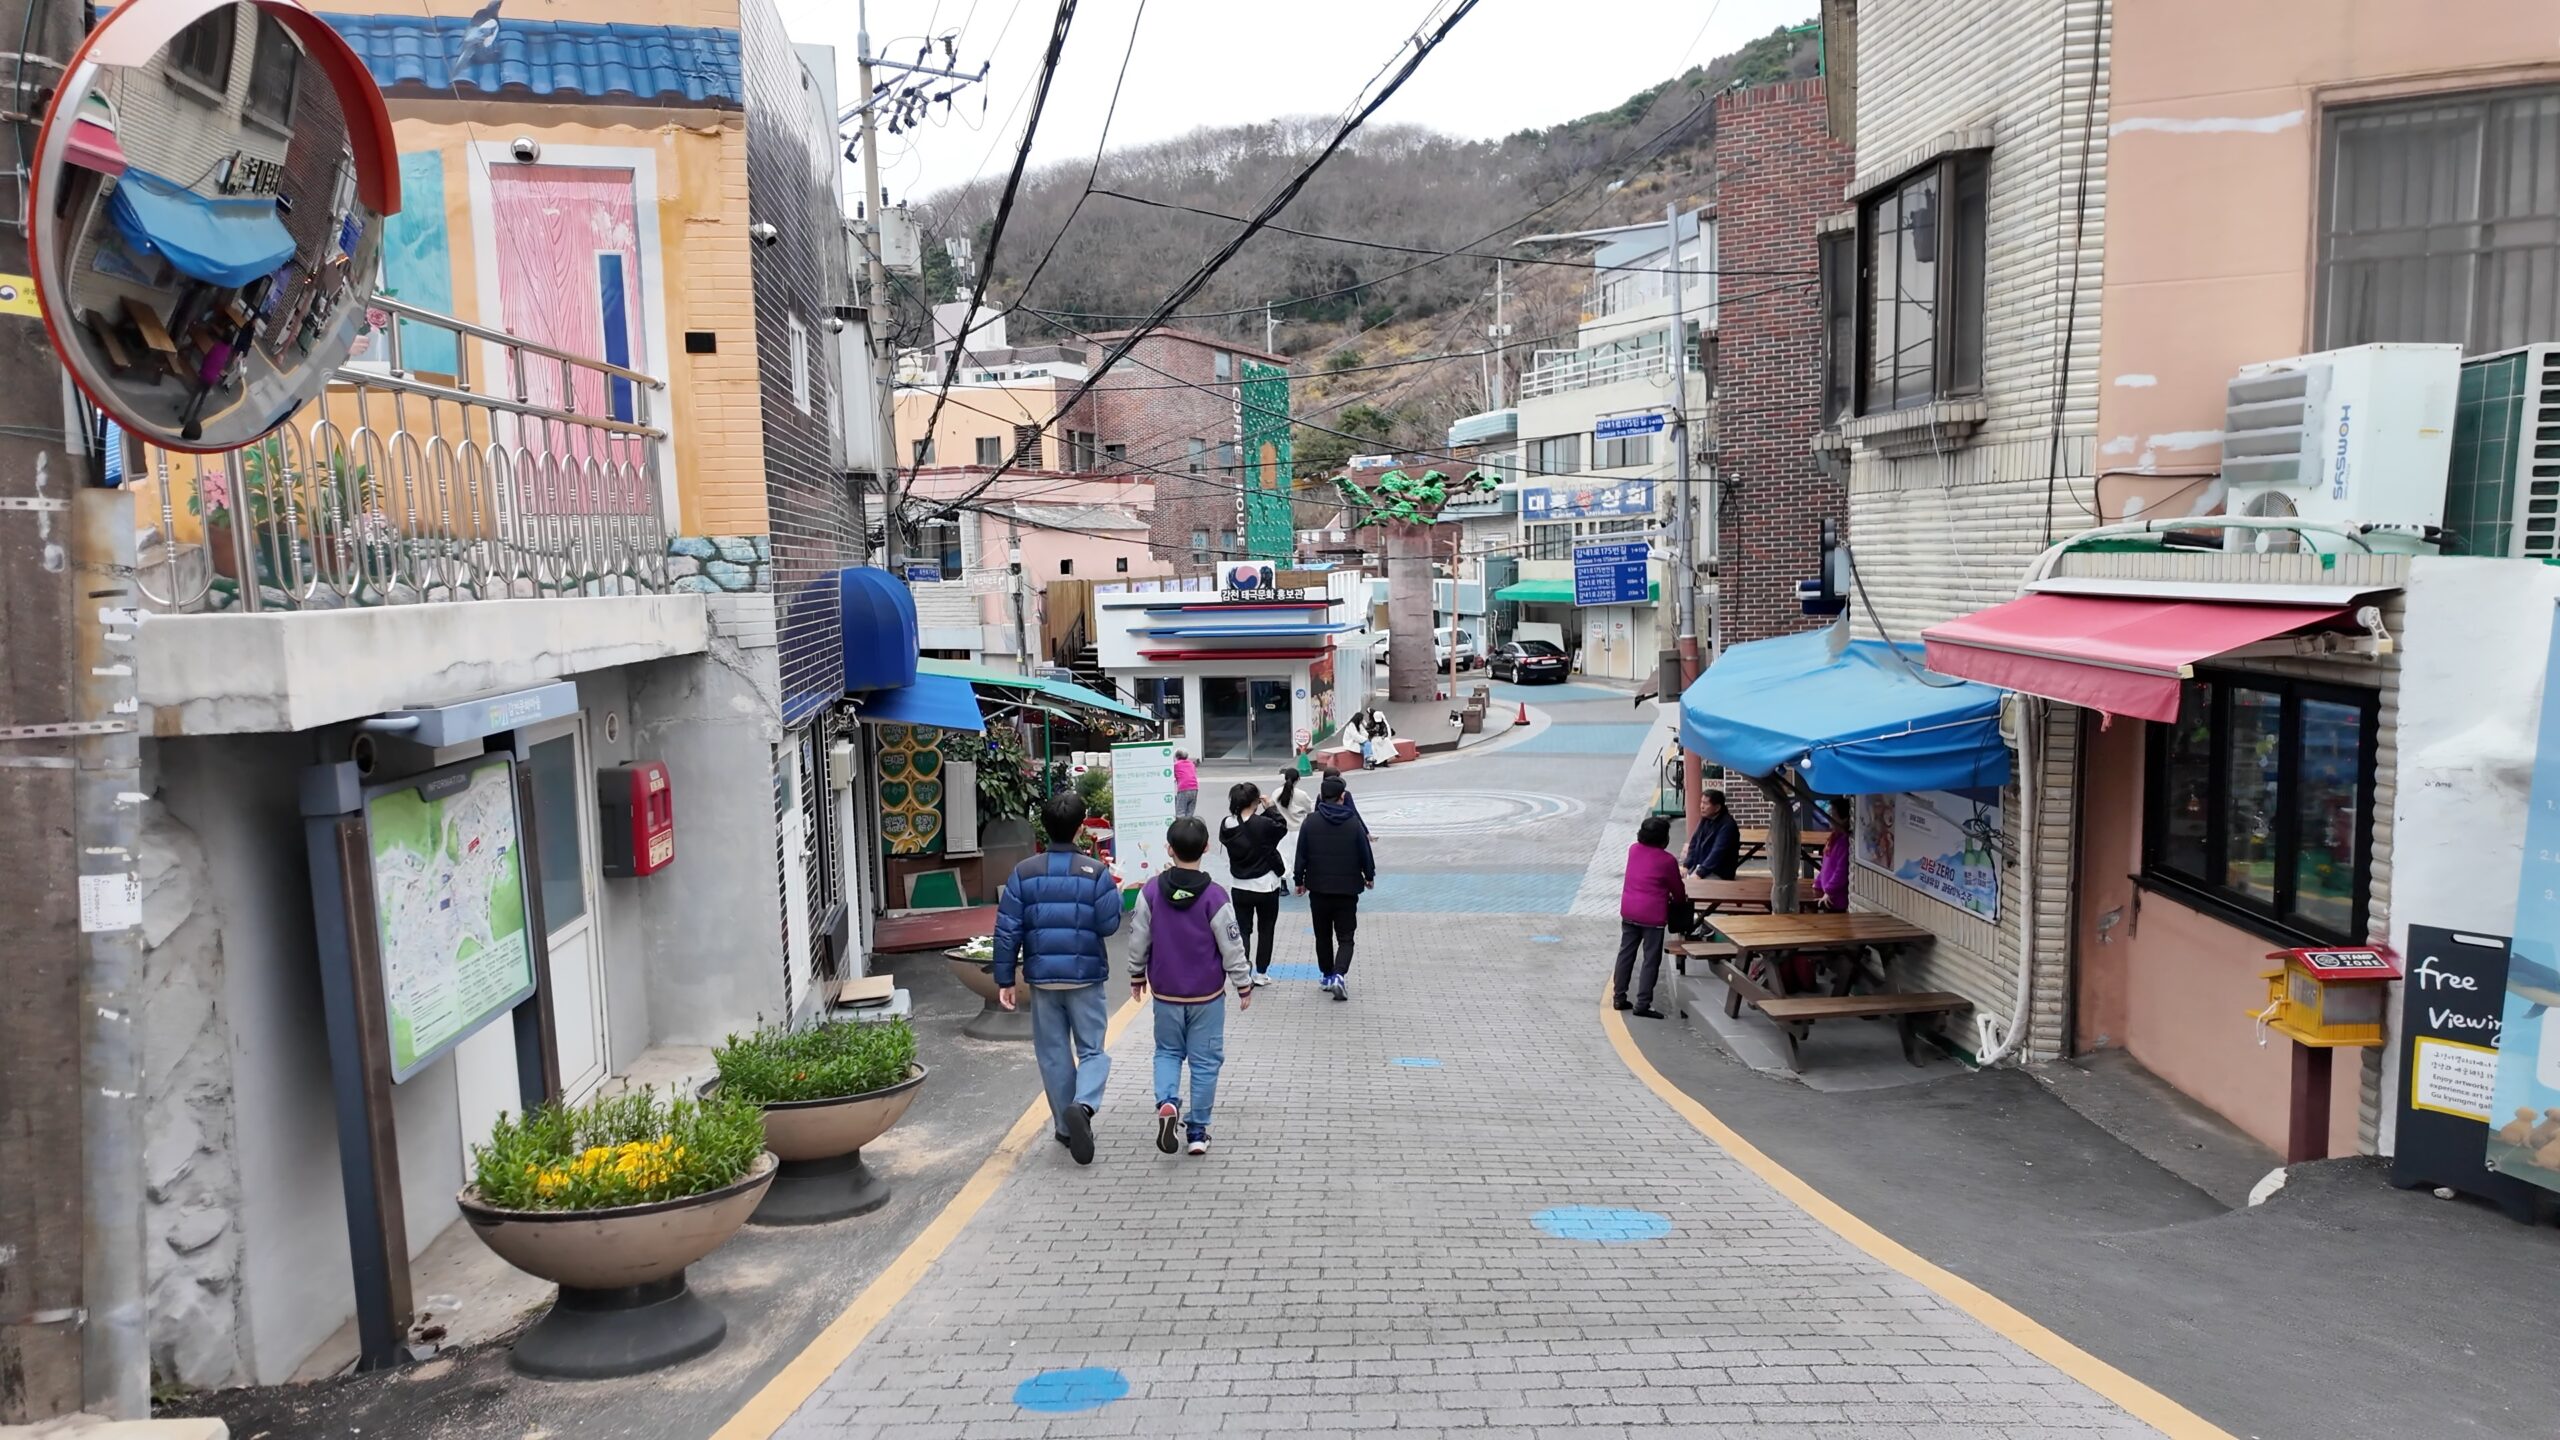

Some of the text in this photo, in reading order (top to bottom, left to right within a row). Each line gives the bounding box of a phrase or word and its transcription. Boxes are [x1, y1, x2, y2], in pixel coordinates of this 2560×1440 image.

[1232, 386, 1243, 456] COFFEE
[1235, 483, 1246, 547] HOUSE
[1221, 588, 1304, 601] 감천 태극문화 홍보관
[1936, 863, 1955, 881] ZERO
[2414, 956, 2478, 991] free
[2430, 1083, 2470, 1096] experience
[2433, 1074, 2453, 1083] Enjoy
[2454, 1079, 2489, 1091] artworks
[2443, 1094, 2476, 1106] kyungmi
